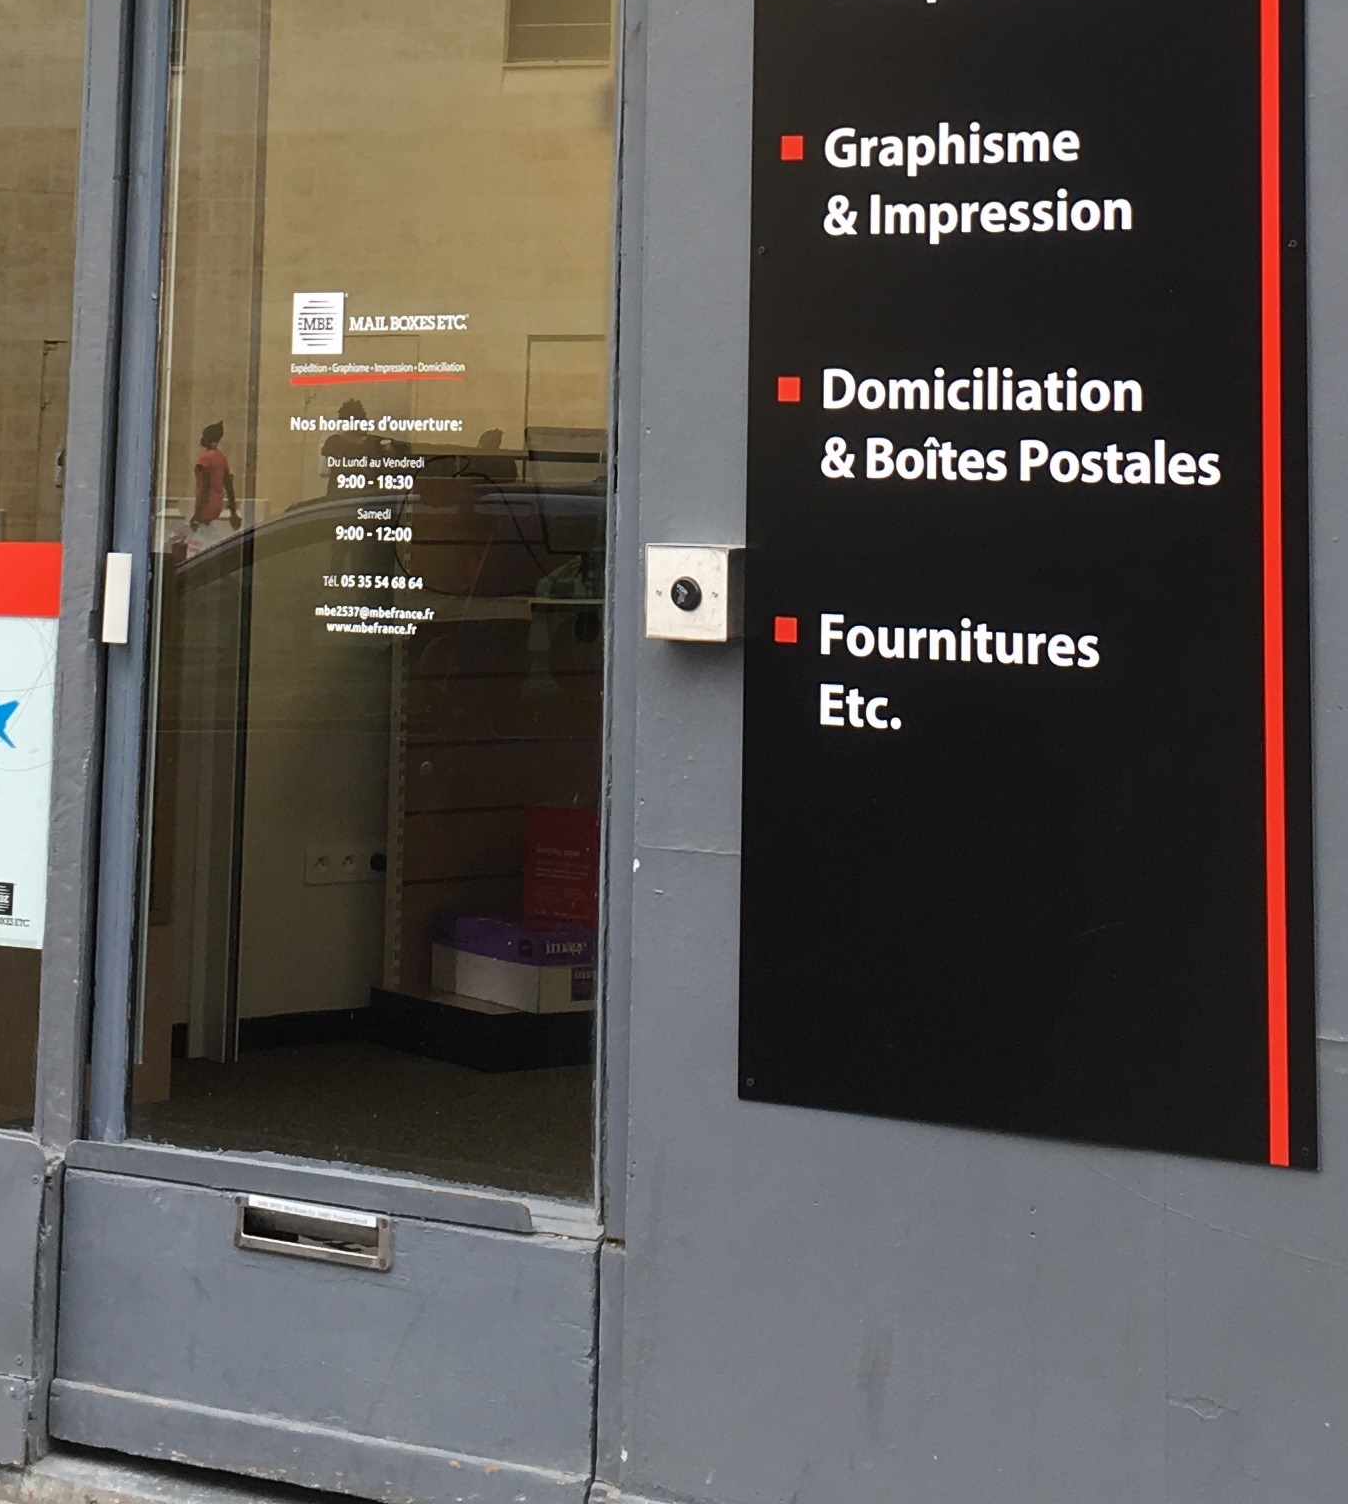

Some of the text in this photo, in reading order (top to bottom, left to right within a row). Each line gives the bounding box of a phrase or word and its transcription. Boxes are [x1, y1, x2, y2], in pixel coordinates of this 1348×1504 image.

[824, 122, 1080, 176] Graphisme
[823, 188, 1132, 244] & Impression
[302, 317, 334, 330] MBE
[349, 314, 467, 331] MAIL BOXES ETC.
[290, 361, 466, 375] Expédition Graphisme Impression Domiciliation
[822, 366, 1143, 411] Domiciliation
[290, 417, 316, 431] Nos
[319, 416, 375, 431] horaires
[327, 456, 425, 469] Du Lundi au Vendredi
[820, 435, 1222, 485] & Boîtes Postales
[337, 474, 365, 489] 9:00
[377, 475, 414, 490] 18:30
[357, 508, 392, 520] Samedi
[335, 526, 364, 541] 9:00
[376, 527, 412, 541] 12:00
[341, 575, 355, 588] 05
[357, 575, 372, 588] 35
[374, 576, 389, 588] 54
[391, 576, 406, 589] 68
[408, 577, 423, 589] 64
[315, 604, 435, 620] mbe2537@mbefrance.fr
[326, 621, 417, 635] www.mbefrance.fr
[820, 613, 1100, 667] Fournitures
[820, 683, 902, 729] Etc.
